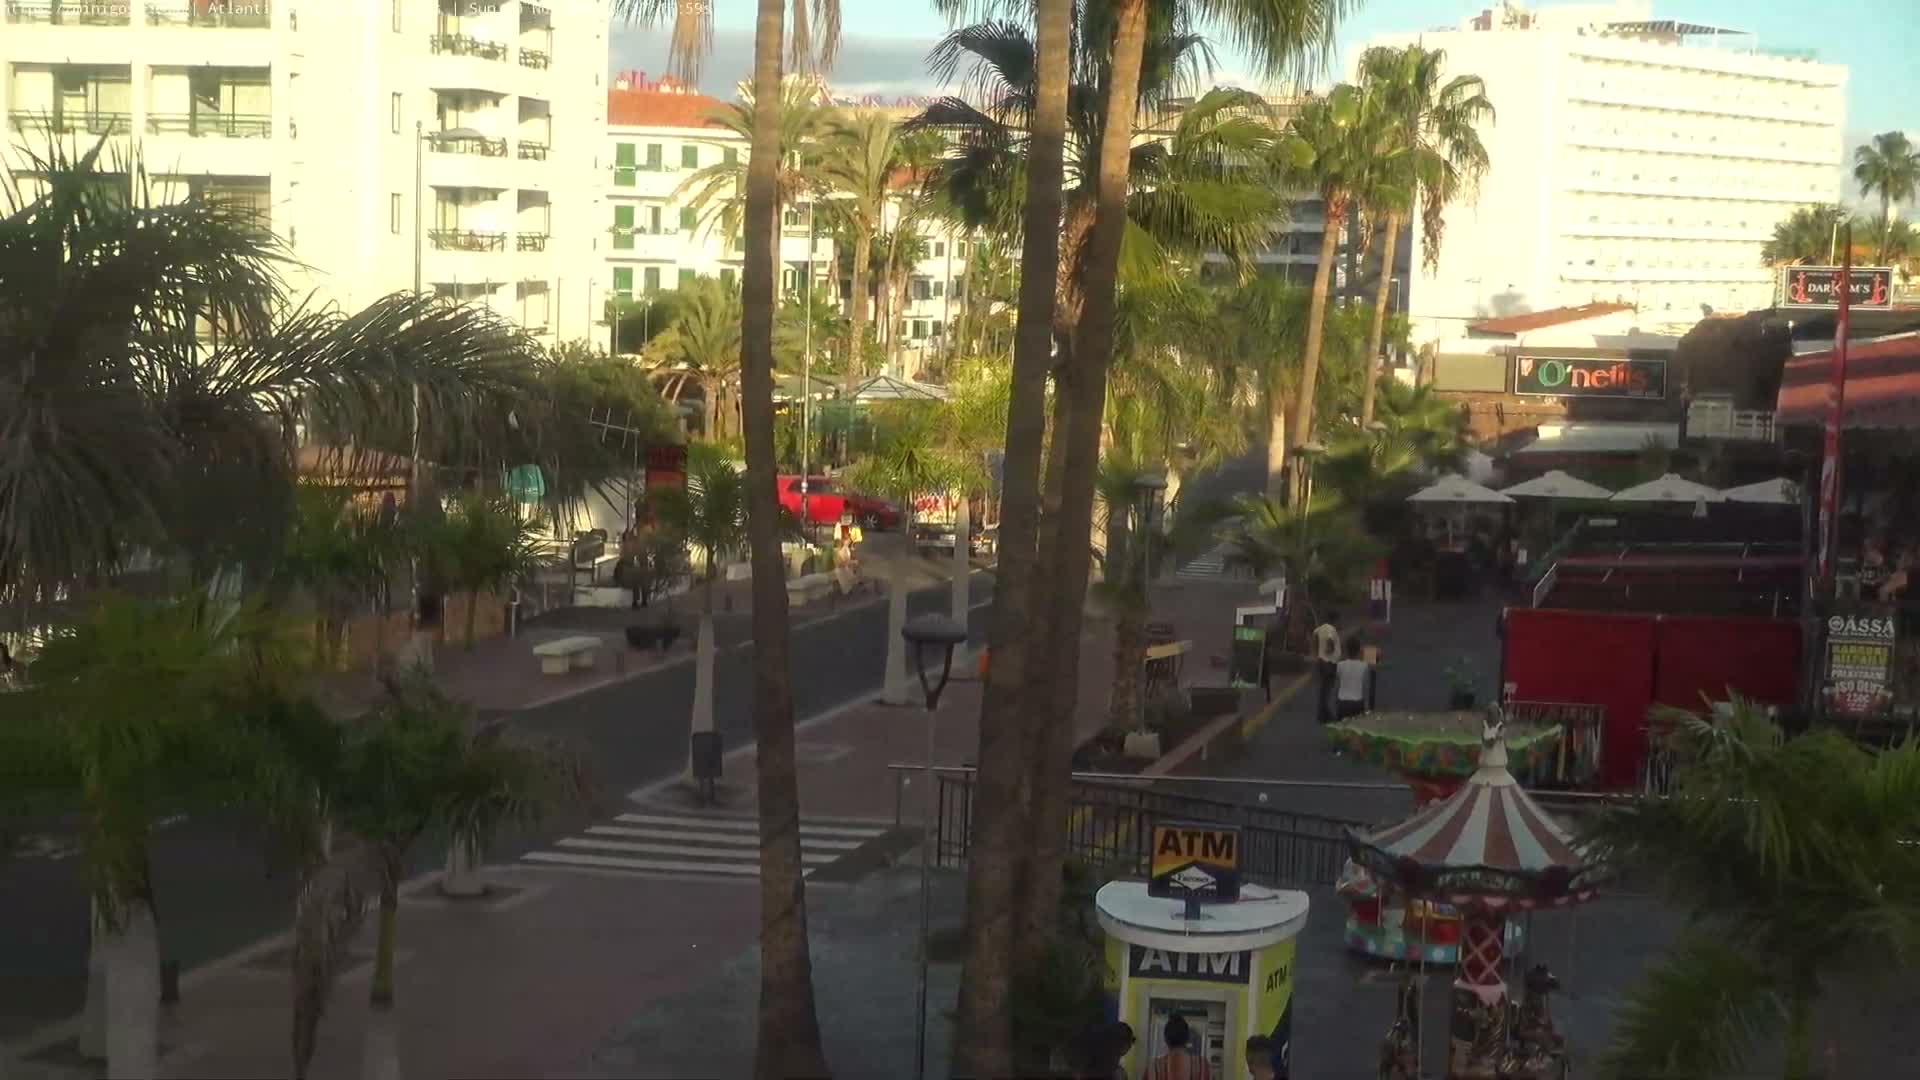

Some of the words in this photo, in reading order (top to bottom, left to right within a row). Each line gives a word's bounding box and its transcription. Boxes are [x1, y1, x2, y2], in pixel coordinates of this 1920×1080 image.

[1808, 279, 1870, 296] DARKM'S
[1158, 829, 1233, 860] ATM
[1138, 948, 1240, 976] ATM
[1265, 964, 1287, 993] ATM
